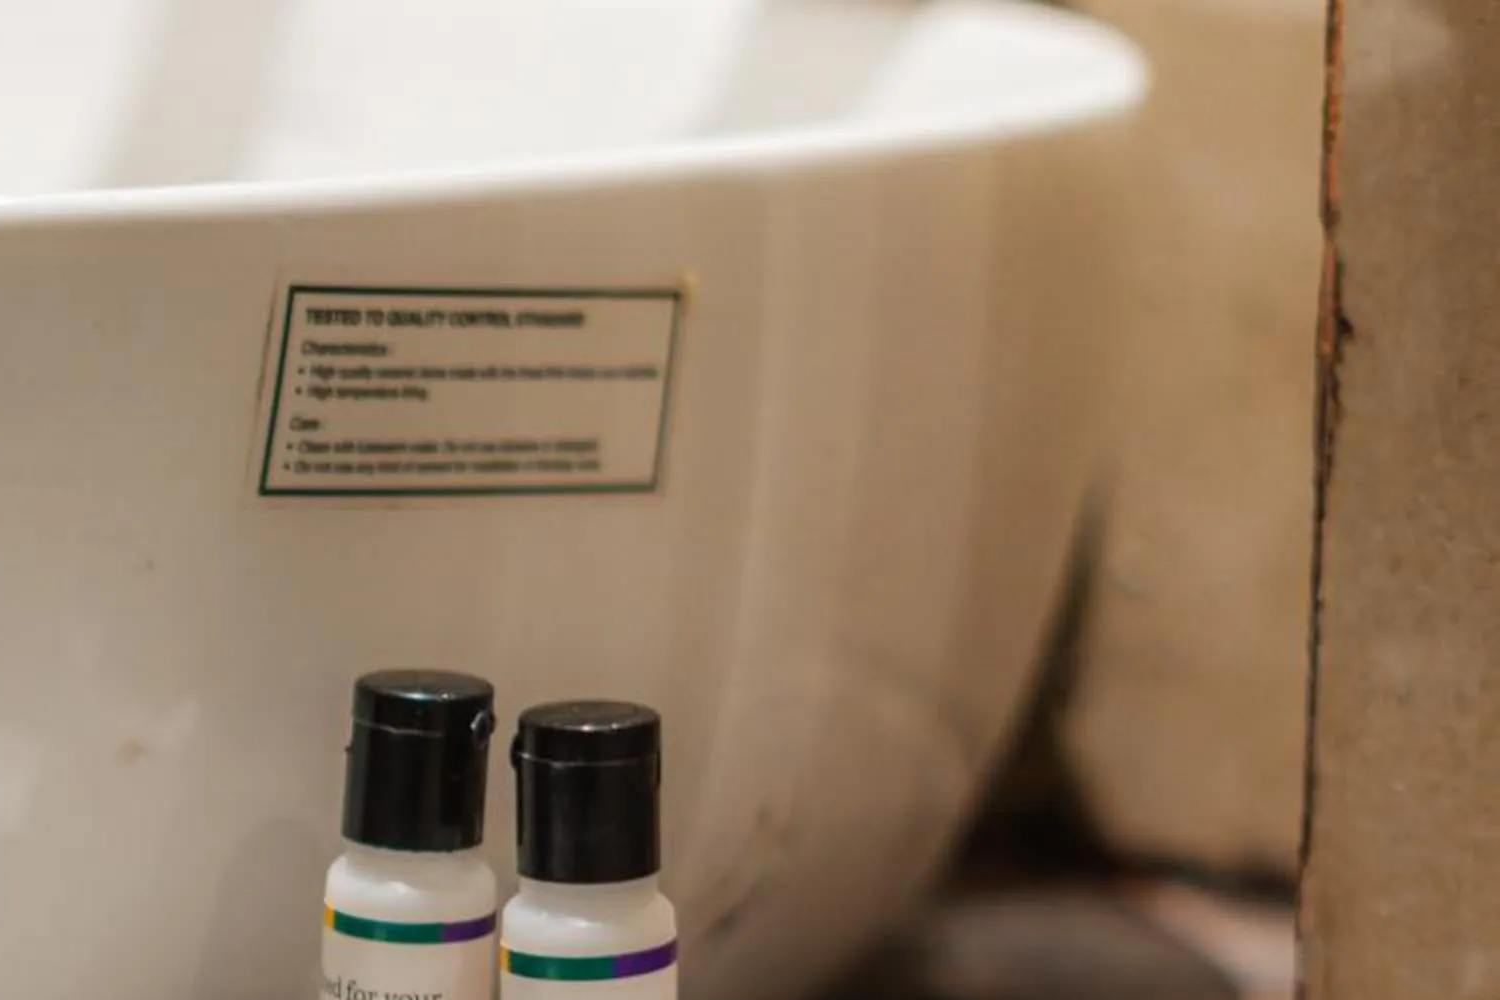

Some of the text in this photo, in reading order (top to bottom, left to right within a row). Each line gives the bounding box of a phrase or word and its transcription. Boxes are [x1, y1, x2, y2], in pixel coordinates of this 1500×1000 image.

[365, 309, 384, 326] TO
[386, 309, 445, 327] QUALITY
[448, 310, 510, 328] CONTROL
